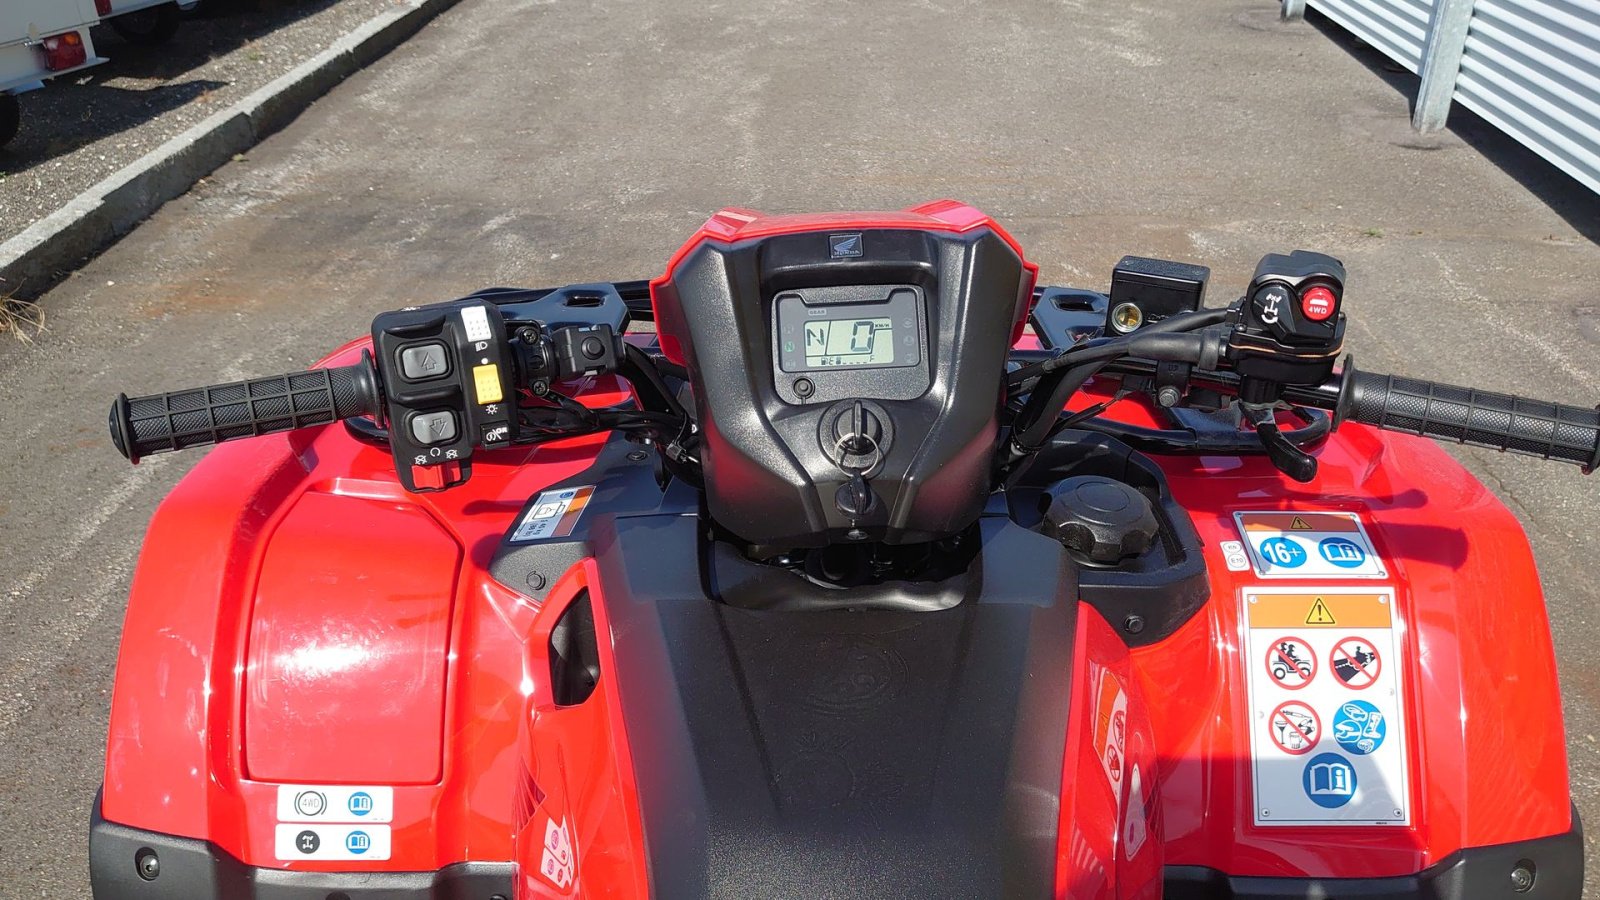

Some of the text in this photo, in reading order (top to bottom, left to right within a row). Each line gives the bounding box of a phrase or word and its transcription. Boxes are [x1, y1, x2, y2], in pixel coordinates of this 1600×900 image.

[1308, 306, 1327, 314] 4WD
[806, 328, 824, 346] N
[851, 321, 874, 352] 0
[1264, 542, 1302, 563] 16+
[302, 798, 320, 808] 4WD
